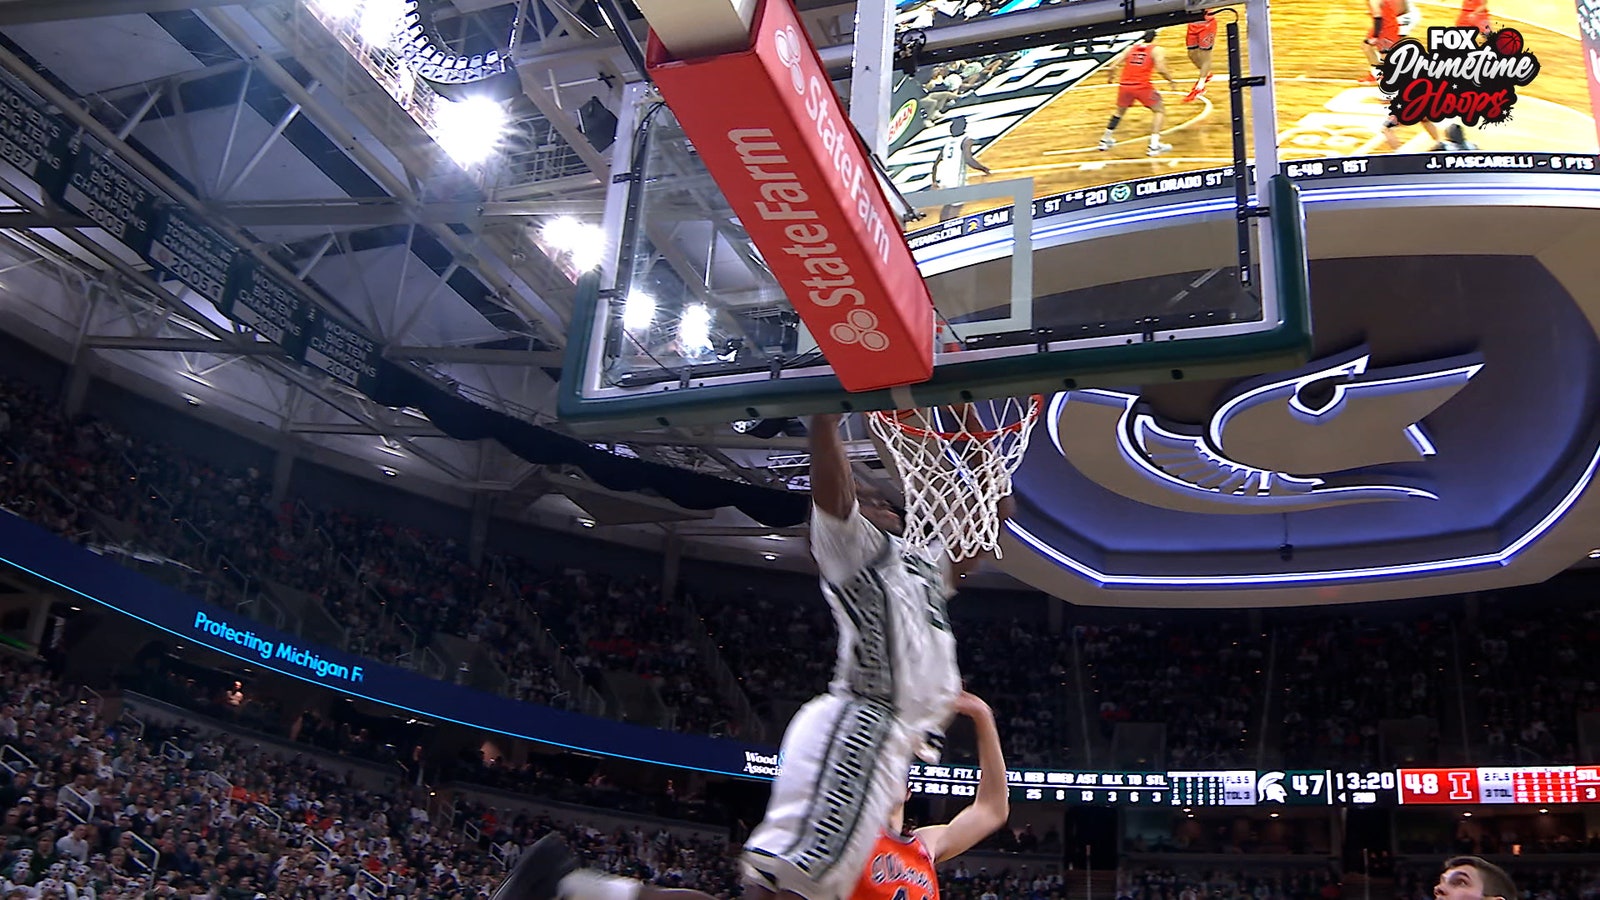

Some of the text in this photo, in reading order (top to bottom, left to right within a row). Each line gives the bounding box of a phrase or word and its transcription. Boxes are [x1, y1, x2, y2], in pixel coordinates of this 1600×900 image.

[24, 119, 51, 147] TEN
[1342, 159, 1369, 174] 1ST
[1426, 156, 1442, 170] J.
[1444, 155, 1533, 169] PASCARELLI
[1565, 156, 1594, 170] PTS
[90, 153, 146, 202] WOMEN'S
[90, 170, 137, 211] BIG TEN
[1136, 174, 1202, 196] COLORADO
[1206, 172, 1223, 187] ST
[73, 173, 148, 232] CHAMPIONS
[1044, 198, 1062, 214] ST
[1085, 189, 1108, 206] 20
[982, 210, 1010, 228] SAN
[163, 235, 227, 284] CHAMPIONS
[170, 258, 210, 293] 2005
[252, 269, 299, 310] WOMEN'S
[252, 285, 293, 319] BIG TEN
[239, 289, 302, 337] CHAMPIONS
[322, 318, 374, 353] WOMEN'S
[325, 332, 367, 361] BIG TEN
[310, 336, 377, 378] CHAMPIONS
[326, 359, 356, 383] 2014
[194, 611, 274, 660] Protecting
[275, 642, 349, 680] Michigan
[744, 751, 778, 766] Wood
[1024, 771, 1045, 783] REB
[1076, 773, 1099, 785] AST
[1145, 774, 1168, 786] STL
[1291, 774, 1325, 796] 47
[1335, 771, 1395, 790] 13:20
[1404, 772, 1439, 795] 48
[1107, 791, 1118, 803] 3
[1130, 791, 1140, 803] 6
[1152, 791, 1163, 803] 3
[1585, 787, 1597, 800] 3
